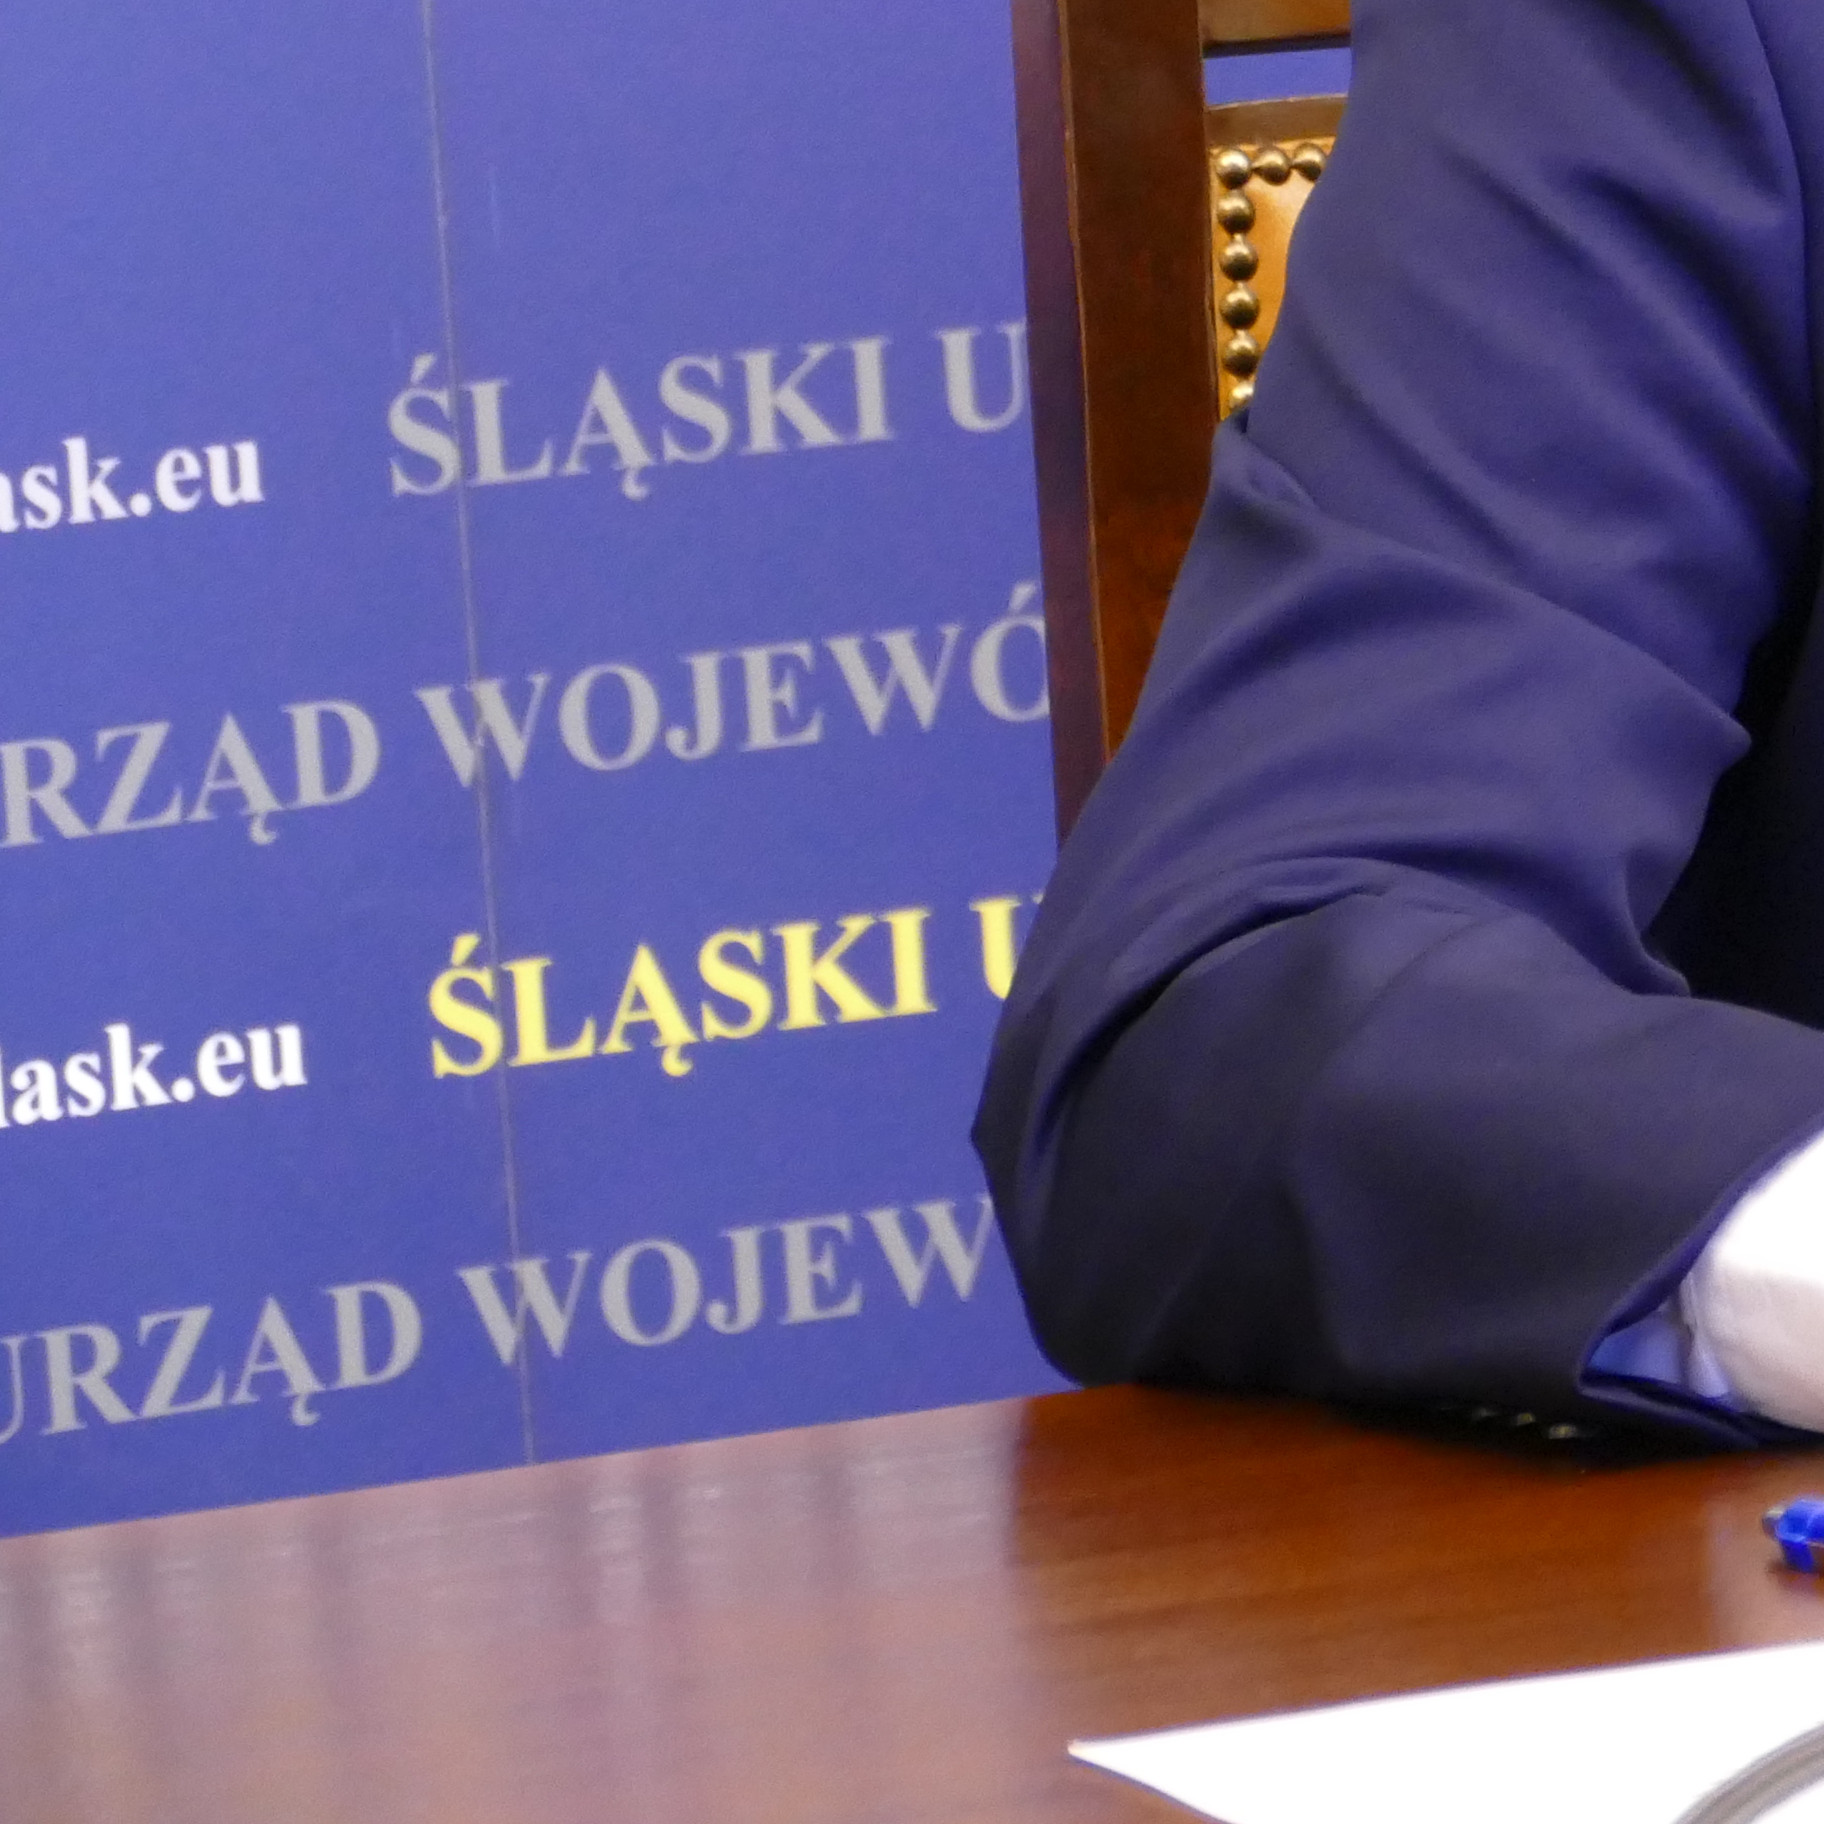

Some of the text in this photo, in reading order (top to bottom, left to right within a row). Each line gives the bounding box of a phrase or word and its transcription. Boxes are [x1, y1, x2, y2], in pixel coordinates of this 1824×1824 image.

[387, 335, 893, 500] ŚLĄSKI
[0, 1021, 307, 1129] ask.eu
[427, 906, 937, 1078] ŚLĄSKI
[0, 1279, 423, 1445] RZĄD
